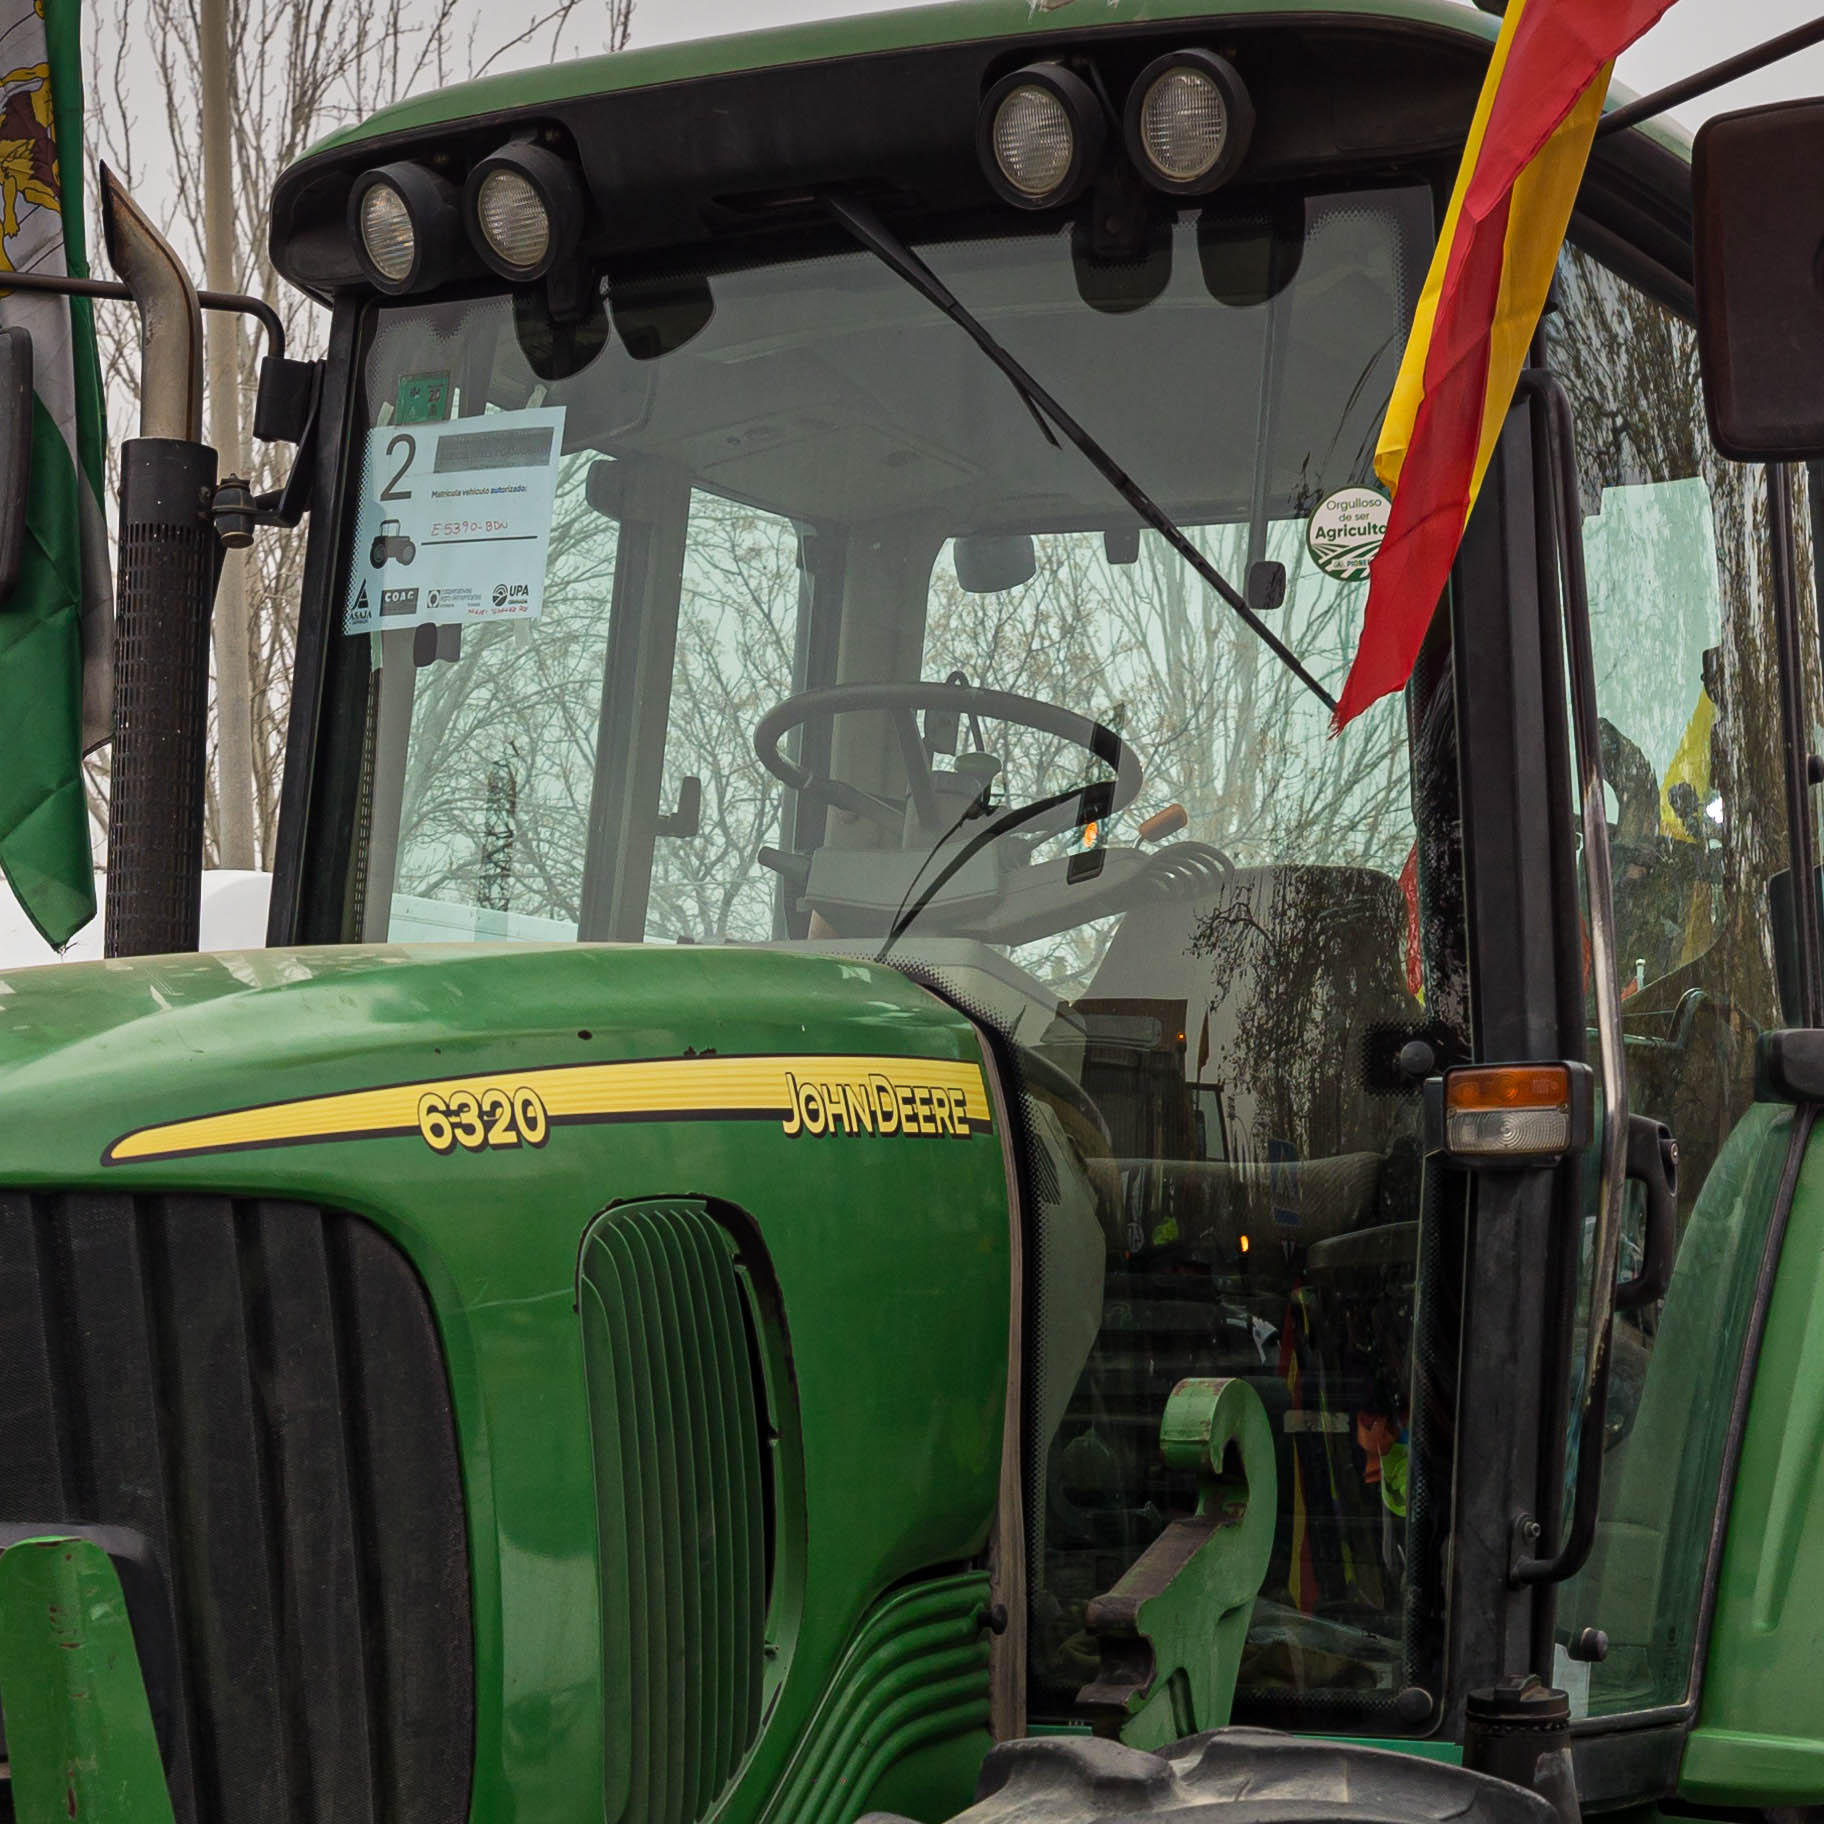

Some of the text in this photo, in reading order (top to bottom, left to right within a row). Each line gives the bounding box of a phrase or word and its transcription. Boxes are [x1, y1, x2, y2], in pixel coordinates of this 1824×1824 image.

[379, 433, 417, 502] 2
[1326, 497, 1383, 512] Orgulloso
[1338, 512, 1370, 522] de ser
[1315, 522, 1387, 542] Agriculto
[384, 590, 415, 603] COAG
[509, 584, 529, 597] UPA
[783, 1072, 972, 1139] JOHN DEERE
[417, 1086, 551, 1157] 6320
